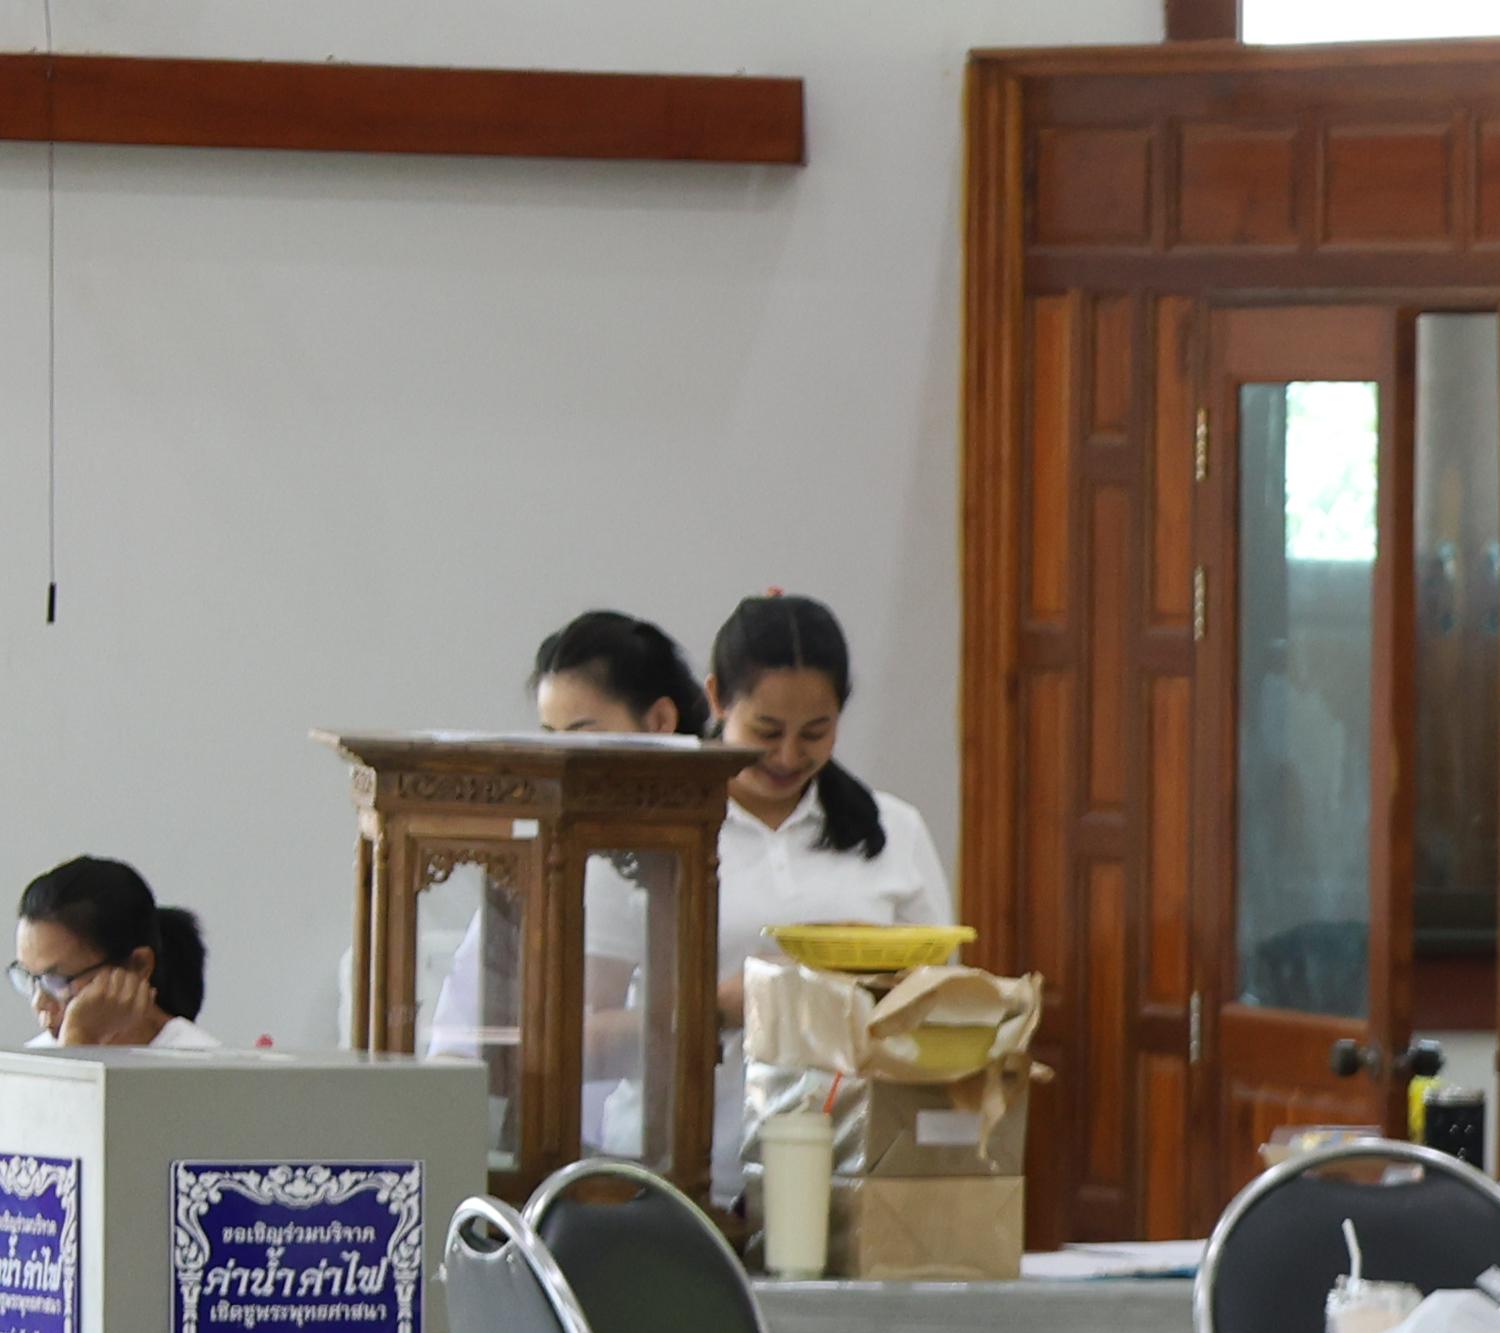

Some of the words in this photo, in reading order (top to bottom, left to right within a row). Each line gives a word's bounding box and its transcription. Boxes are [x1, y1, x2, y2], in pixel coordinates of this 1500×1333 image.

[202, 1246, 296, 1298] ค่าน้ำ
[296, 1250, 389, 1297] ค่าไฟ
